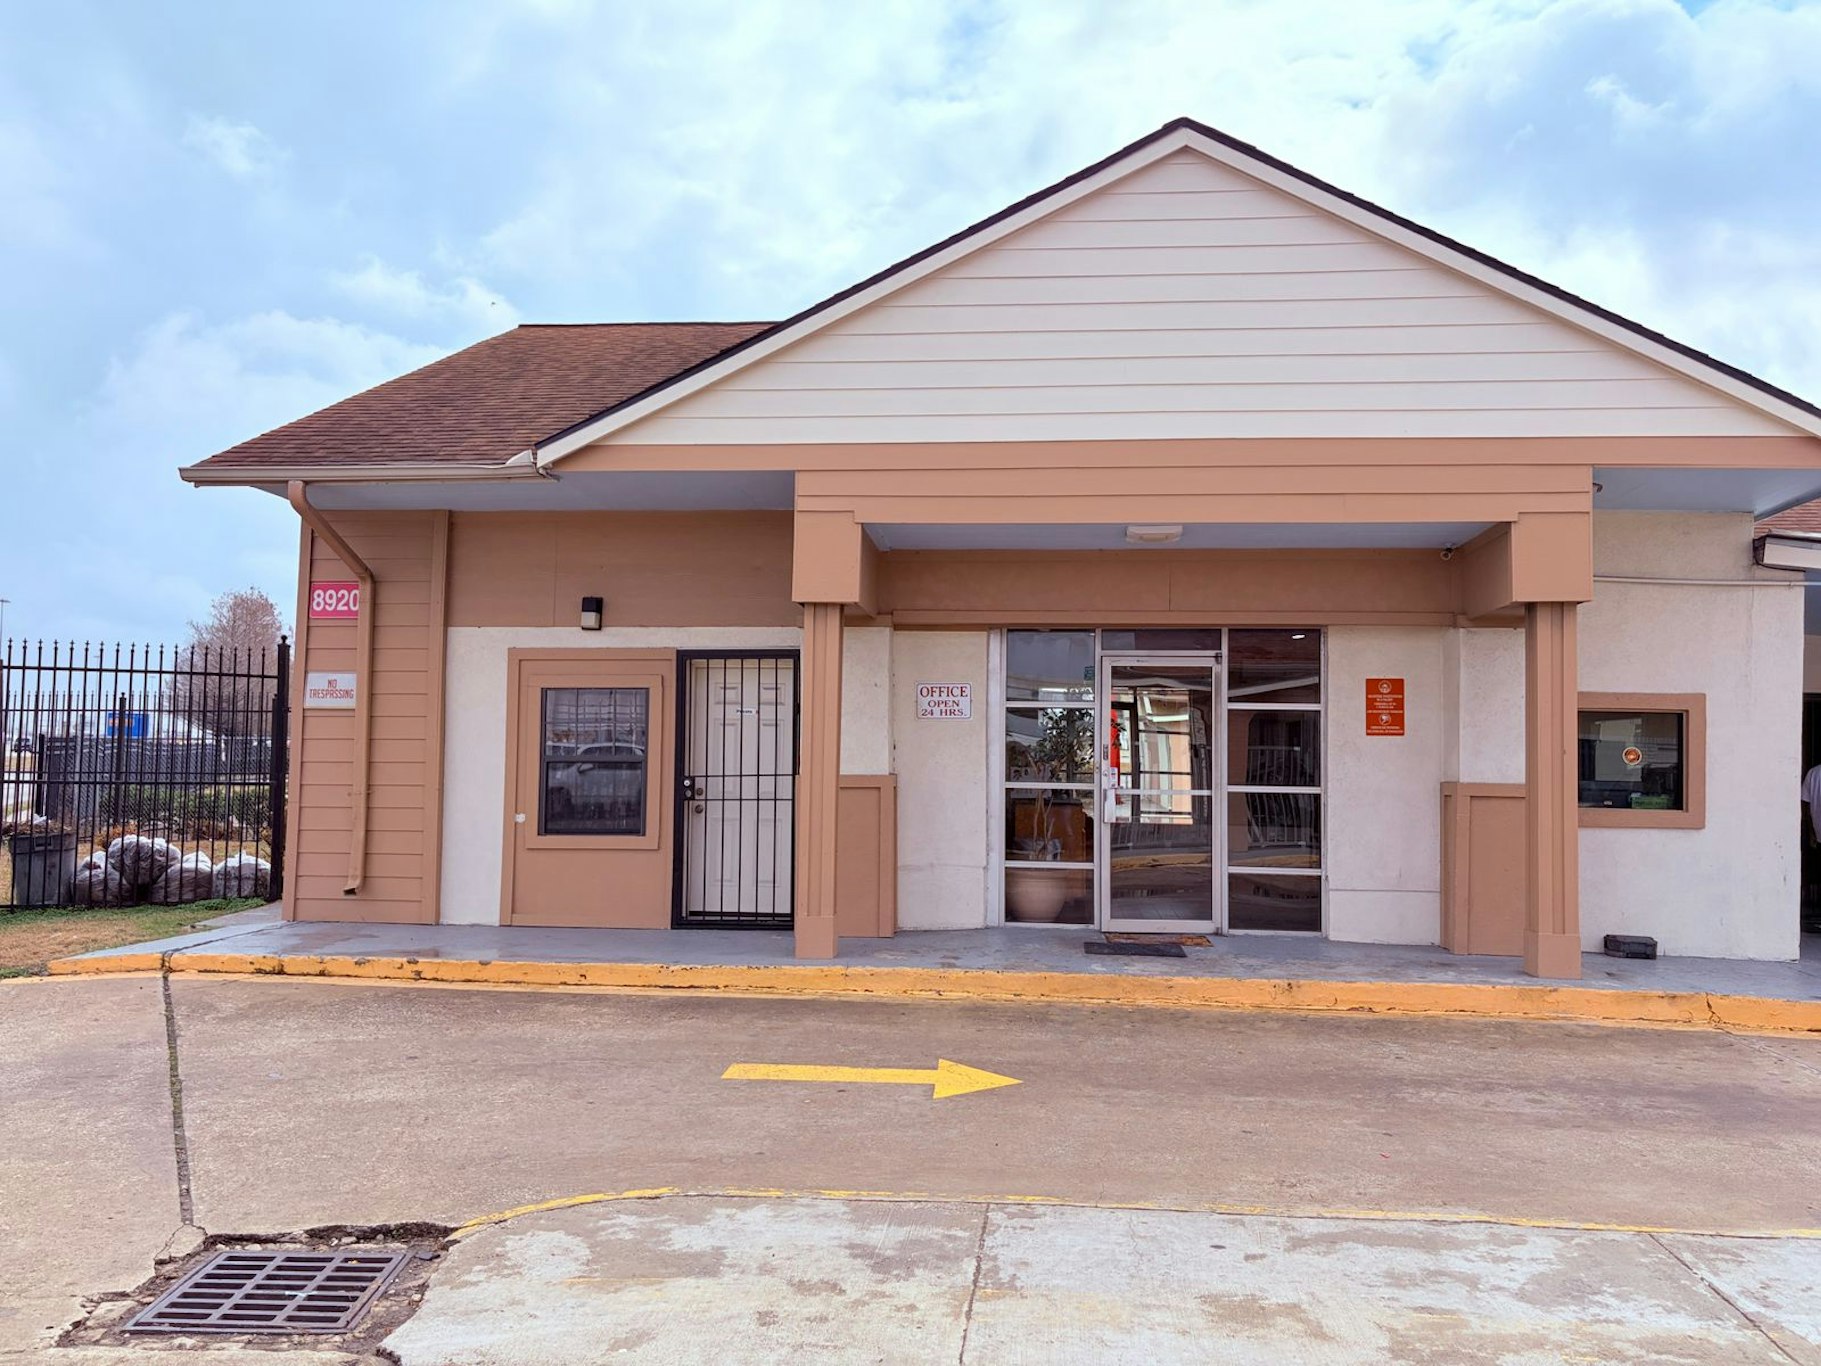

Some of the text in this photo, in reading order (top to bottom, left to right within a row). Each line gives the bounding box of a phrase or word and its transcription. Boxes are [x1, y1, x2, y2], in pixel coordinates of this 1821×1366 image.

[312, 589, 359, 611] 8920
[327, 679, 338, 688] NO
[309, 689, 354, 699] TRESPASSING
[919, 686, 968, 698] OFFICE
[927, 699, 960, 708] OPEN
[921, 708, 967, 716] 24 HRS.
